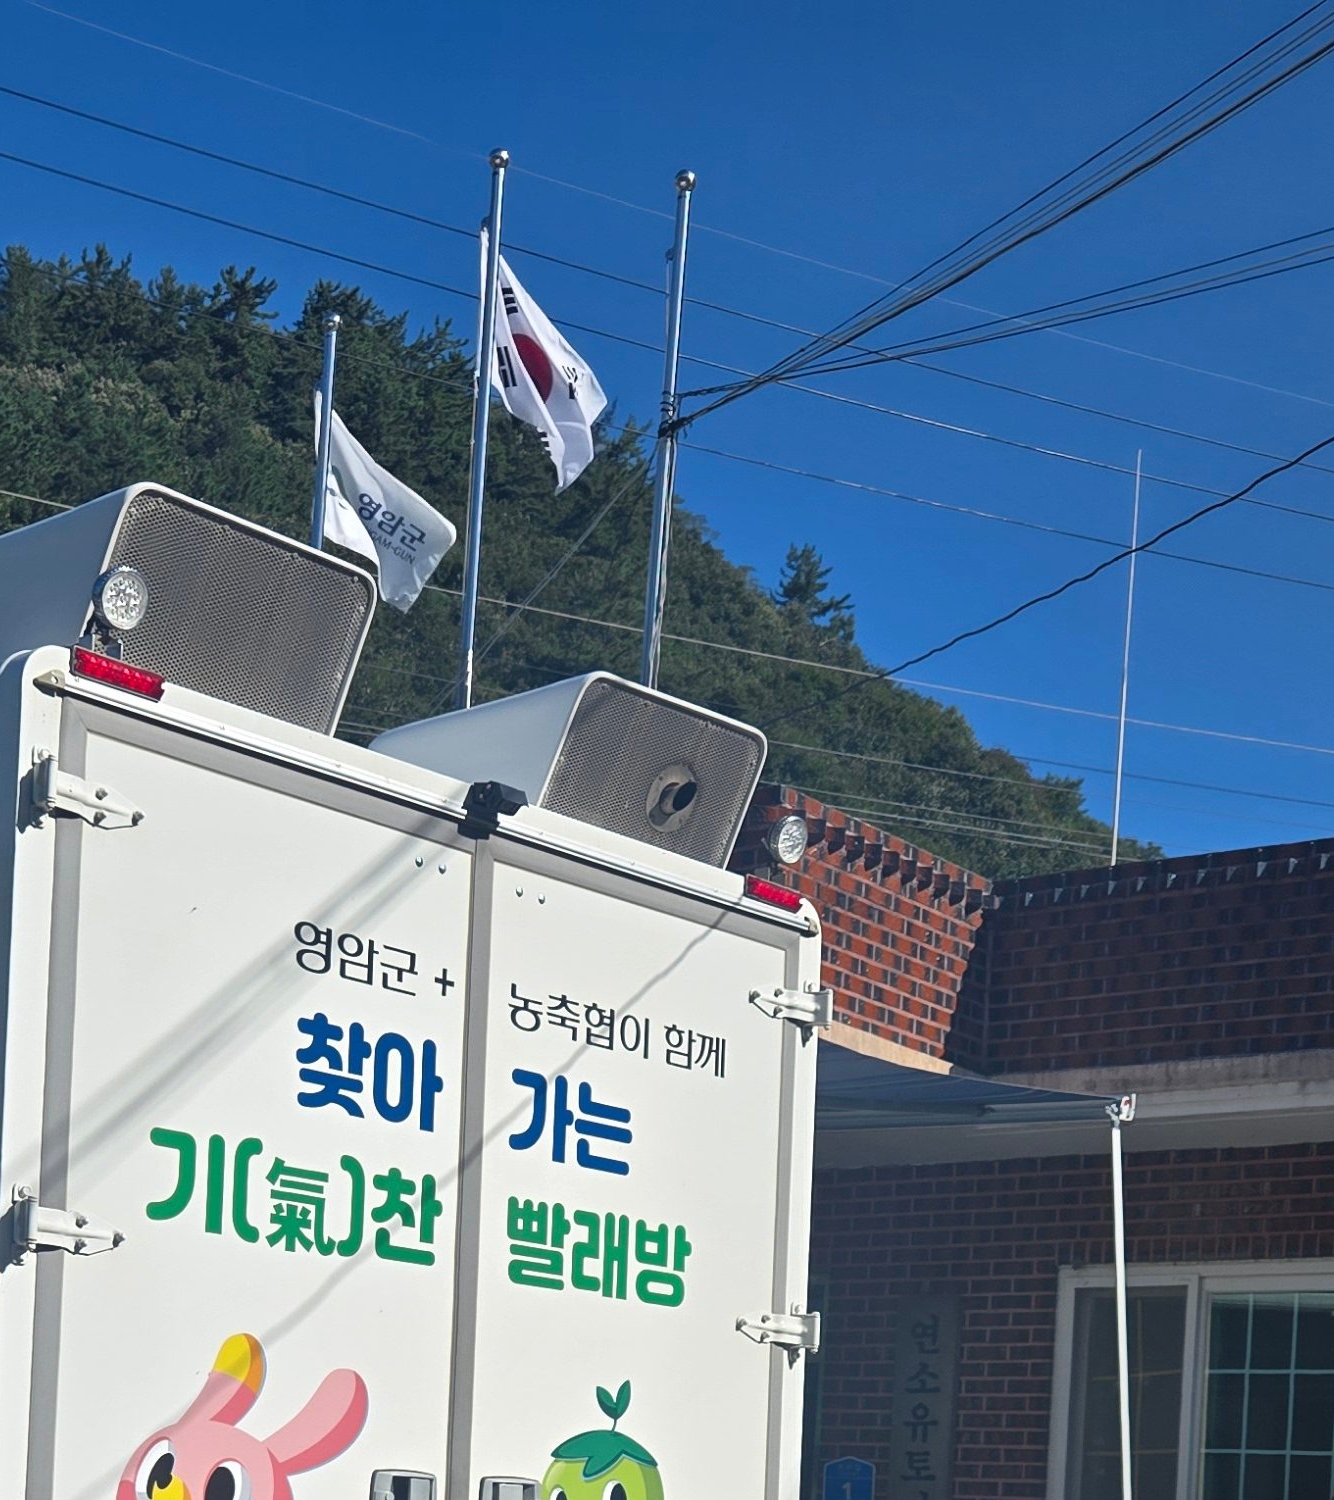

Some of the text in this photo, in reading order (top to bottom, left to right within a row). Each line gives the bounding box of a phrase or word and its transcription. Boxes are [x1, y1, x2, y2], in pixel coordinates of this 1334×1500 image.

[294, 922, 418, 996] 영암군
[508, 983, 649, 1059] 농축협이
[664, 1024, 725, 1078] 함께
[296, 1013, 632, 1175] 찾아 가는
[146, 1127, 691, 1307] 기(氣)찬 빨래방
[842, 1481, 852, 1500] 1
